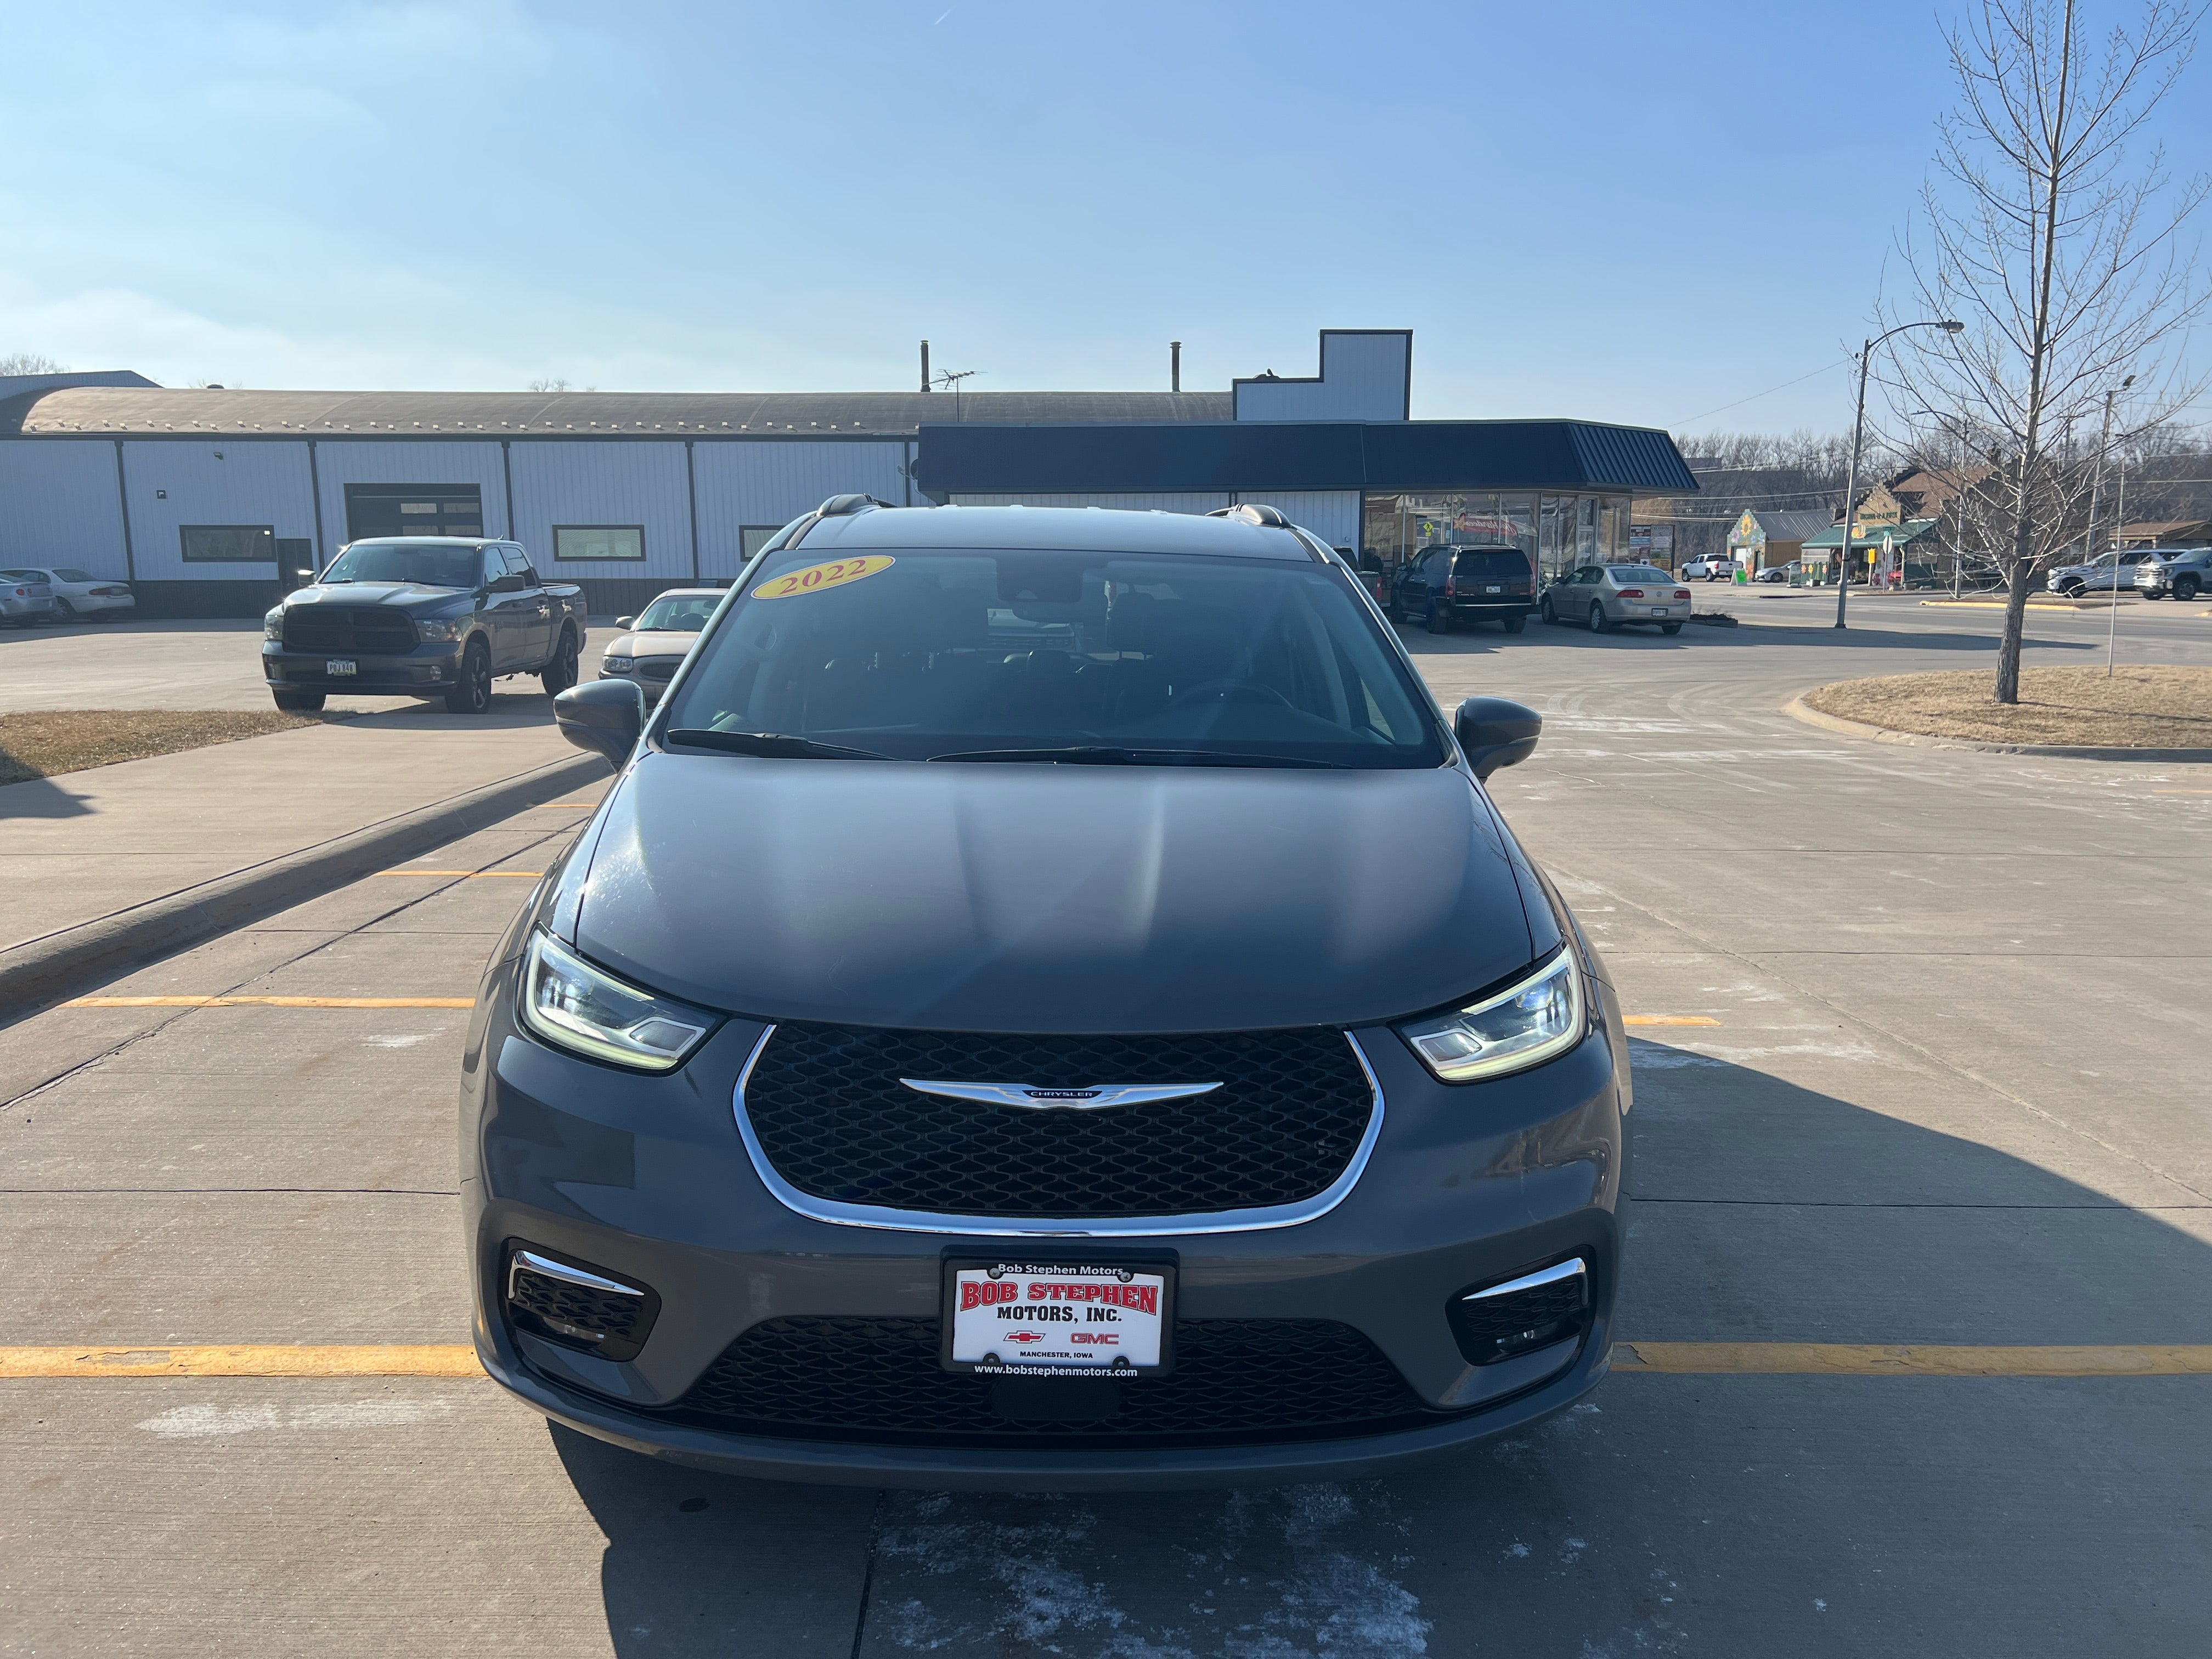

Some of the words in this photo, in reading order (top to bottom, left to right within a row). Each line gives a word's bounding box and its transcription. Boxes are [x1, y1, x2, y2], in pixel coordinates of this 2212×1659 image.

[778, 559, 866, 595] 2022
[998, 1263, 1023, 1273] Bob
[1025, 1265, 1077, 1276] Stephen
[1080, 1266, 1123, 1275] Motors
[961, 1281, 1018, 1311] BOB
[1028, 1283, 1159, 1316] STEPHEN
[997, 1306, 1079, 1324] MOTORS,
[1086, 1307, 1122, 1322] INC.
[1070, 1332, 1119, 1345] GMC
[974, 1364, 1138, 1377] www.bobstephenmotors.com
